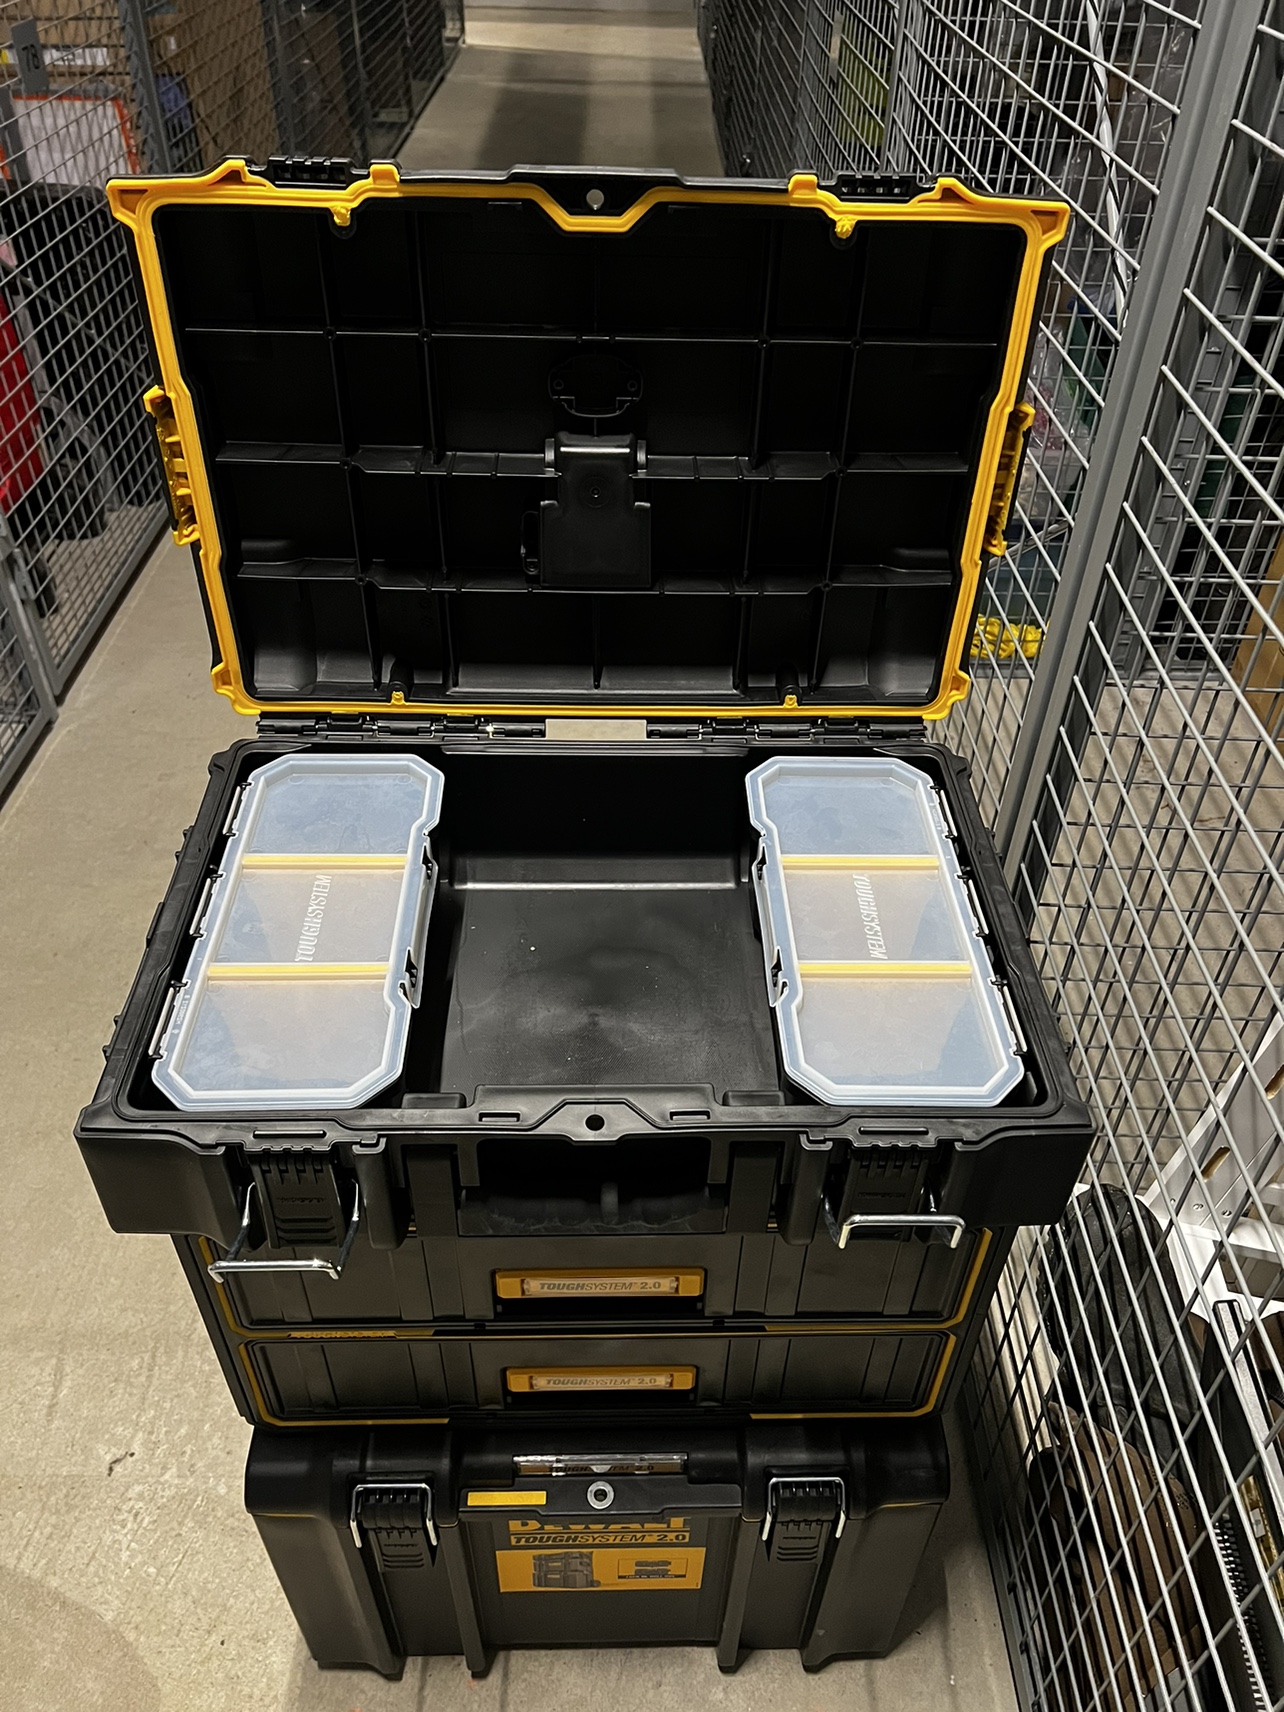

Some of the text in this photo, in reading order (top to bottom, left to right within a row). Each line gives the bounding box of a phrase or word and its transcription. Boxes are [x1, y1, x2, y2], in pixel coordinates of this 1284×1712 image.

[294, 874, 333, 962] TOUGHSYSTEM
[852, 873, 888, 960] TOUGHSYSTEM
[640, 1281, 662, 1290] 2.0
[637, 1377, 657, 1385] 2.0
